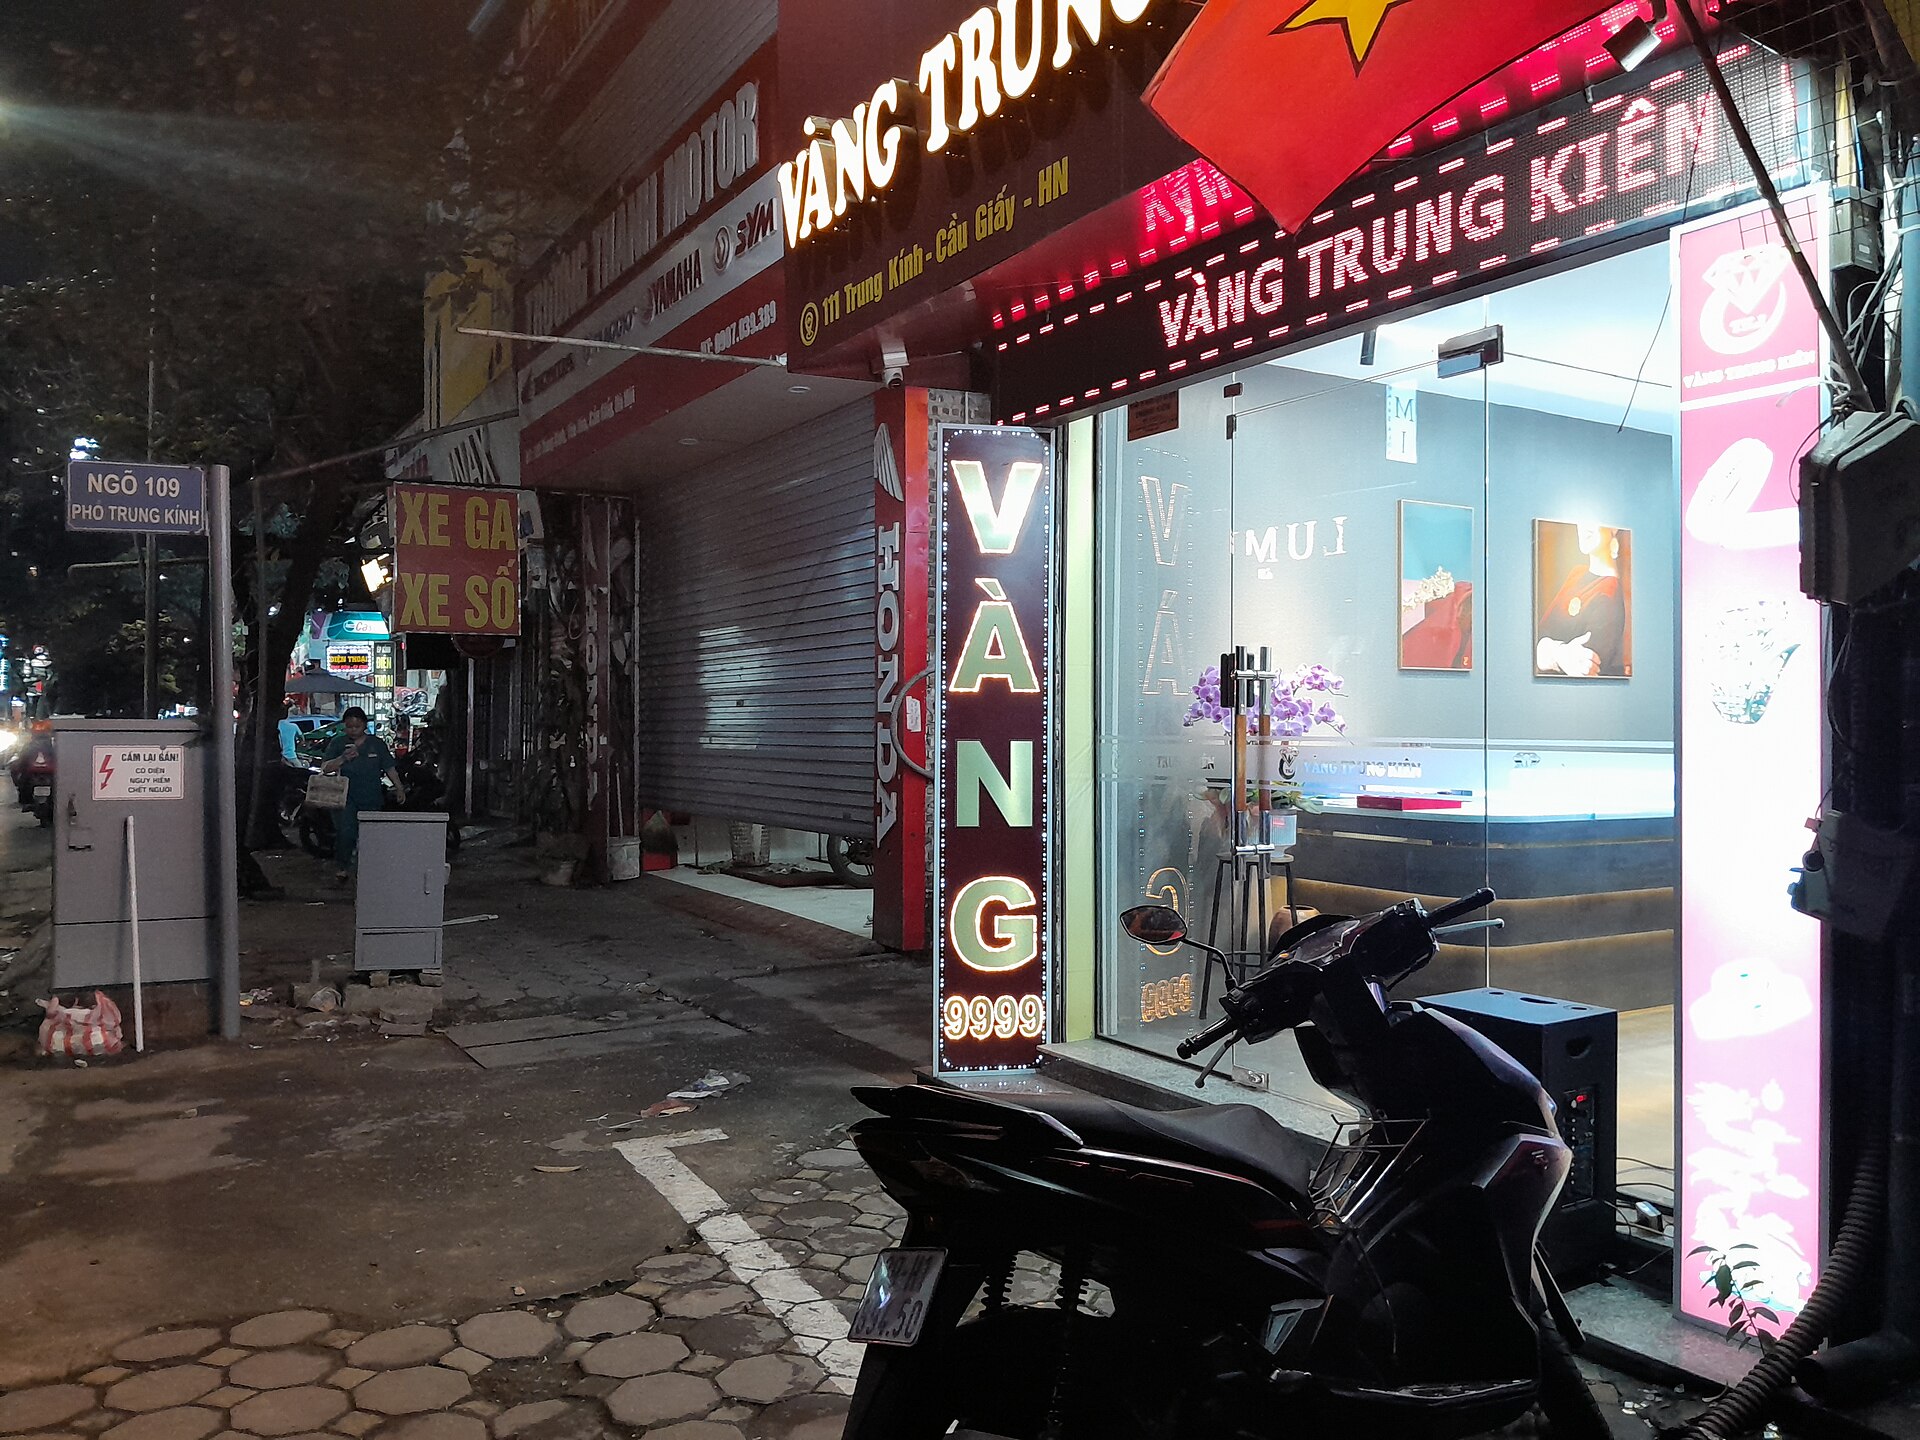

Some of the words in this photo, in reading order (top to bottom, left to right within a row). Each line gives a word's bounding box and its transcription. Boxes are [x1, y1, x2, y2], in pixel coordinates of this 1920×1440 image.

[663, 81, 759, 238] MOTOR
[777, 79, 901, 249] VÀNG
[919, 0, 1149, 153] TRUN
[735, 197, 778, 258] SYM
[823, 294, 840, 328] 111
[845, 267, 884, 316] Trung
[889, 242, 924, 288] Kính
[936, 211, 970, 265] Cầu
[975, 184, 1017, 239] Giấy
[1037, 157, 1070, 208] HN
[1158, 257, 1284, 348] VÀNG
[1298, 174, 1505, 299] TRUNG
[71, 499, 104, 521] PHỐ
[108, 505, 159, 523] TRUNG
[164, 503, 201, 526] KÍNH
[87, 468, 138, 497] NGÕ
[145, 476, 181, 498] 109
[400, 491, 451, 547] XE
[464, 499, 515, 551] GA
[400, 573, 451, 627] XE
[464, 558, 515, 630] SỐ
[875, 521, 902, 850] HONDA
[950, 460, 1042, 973] VÀNG
[944, 994, 1044, 1040] 9999
